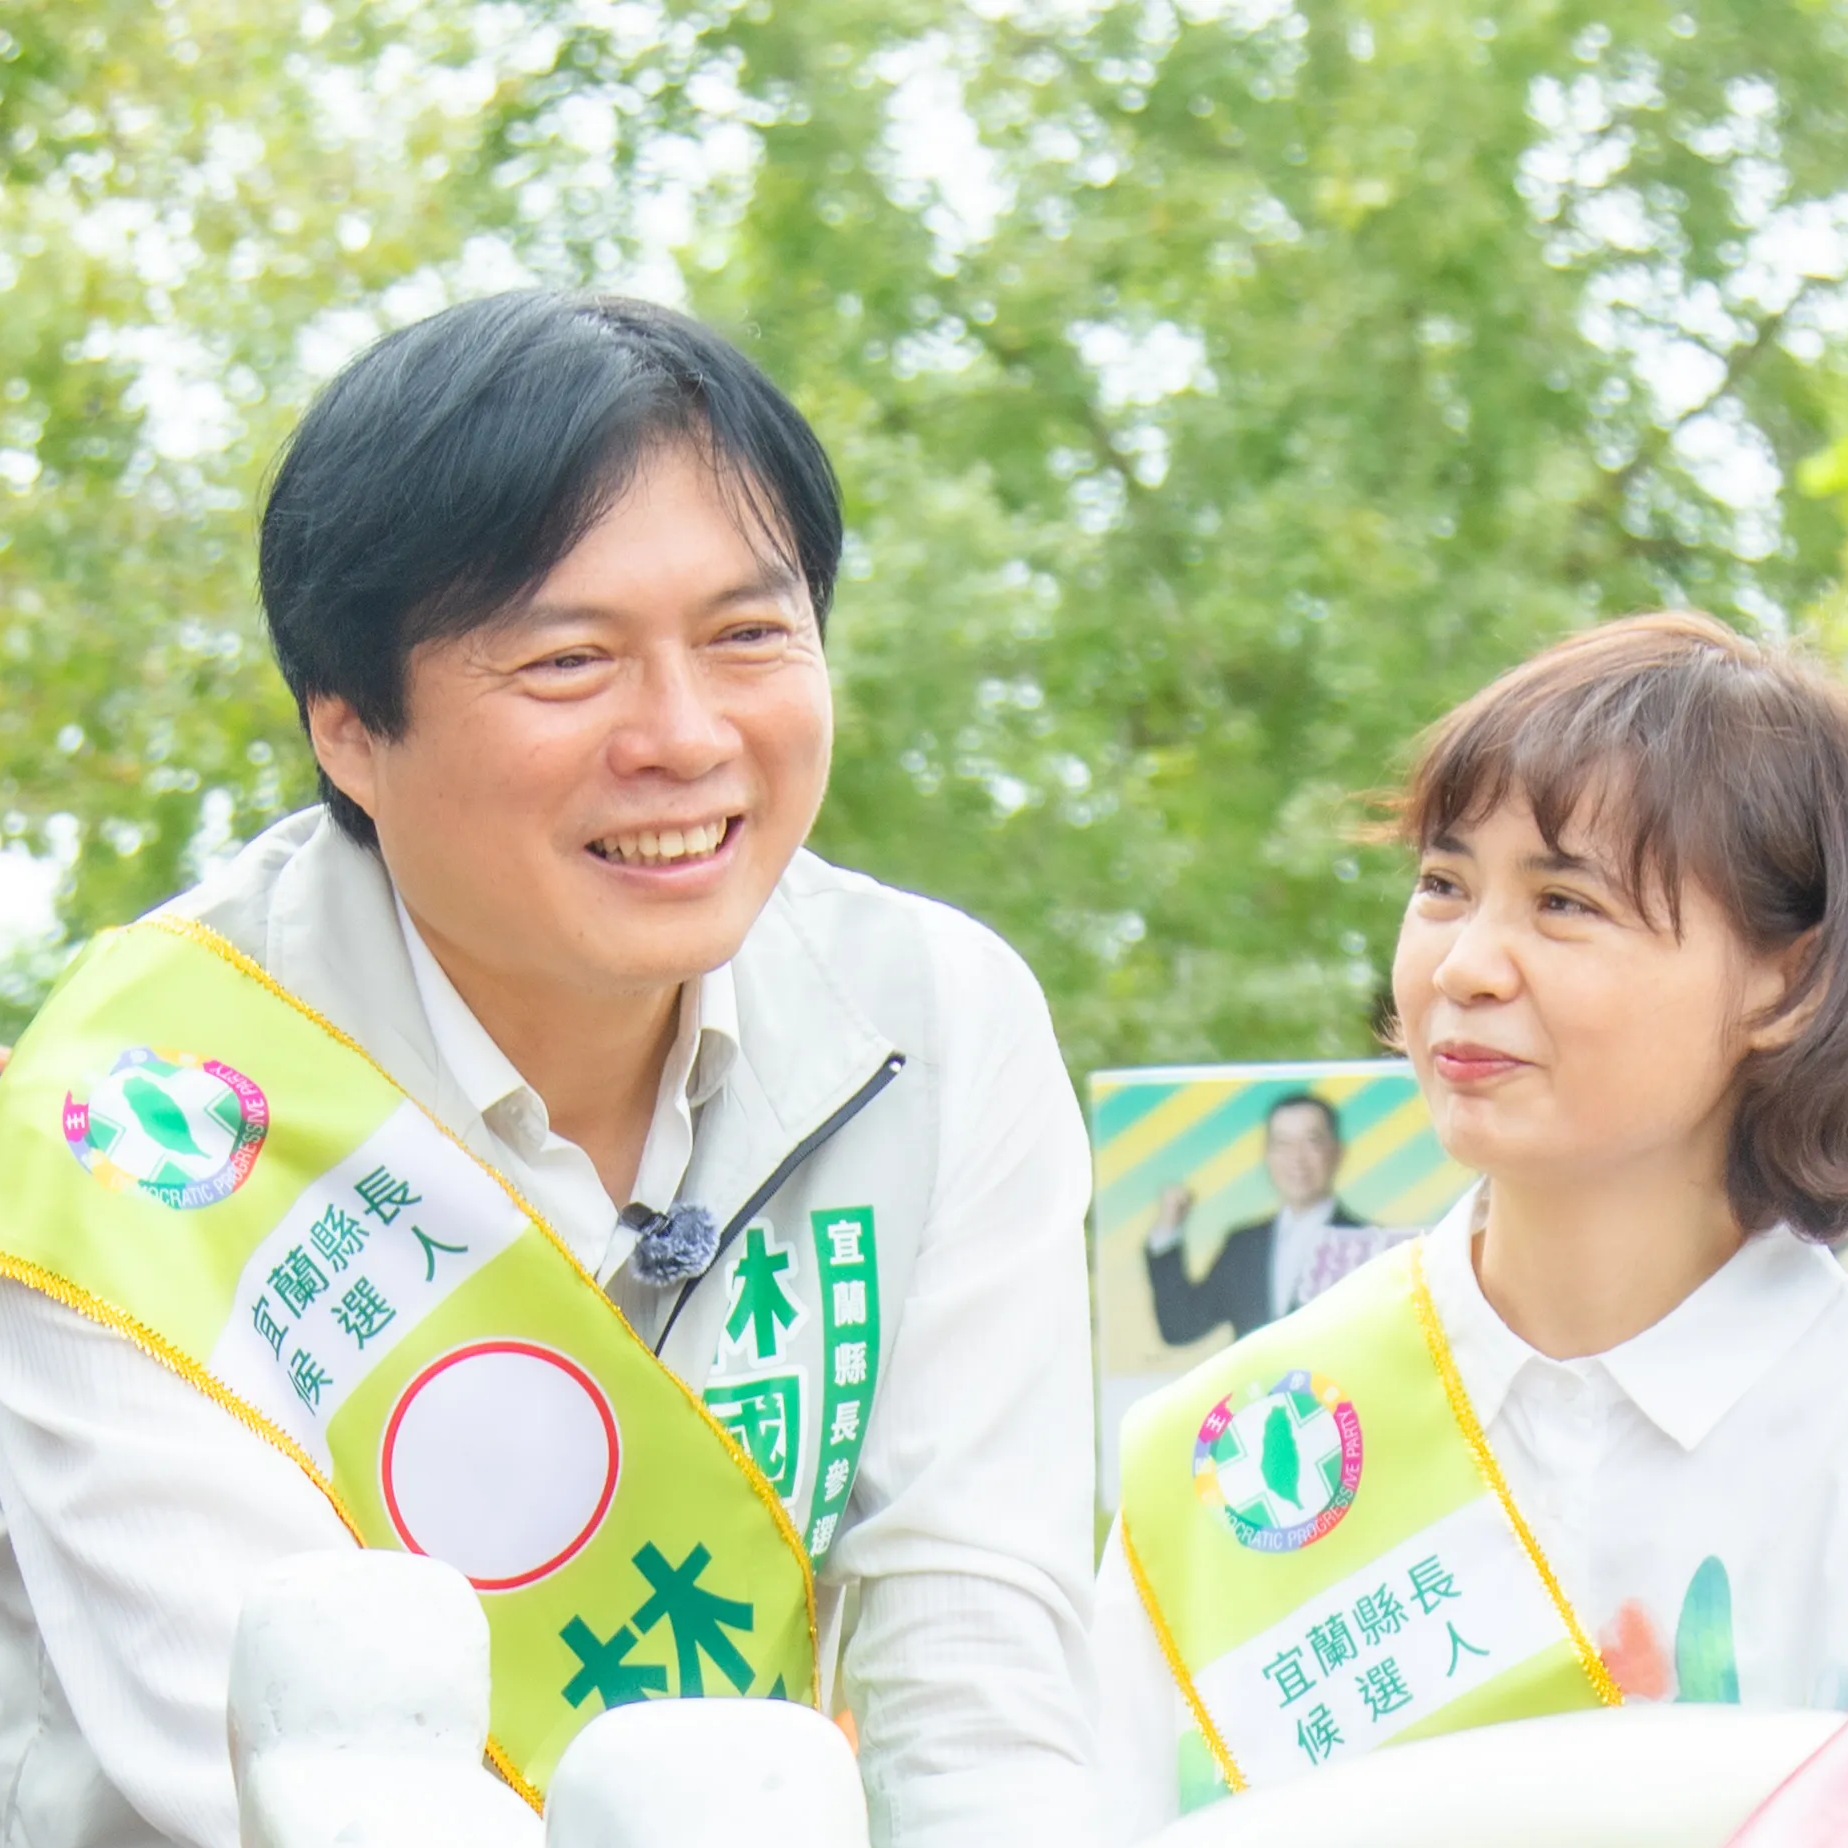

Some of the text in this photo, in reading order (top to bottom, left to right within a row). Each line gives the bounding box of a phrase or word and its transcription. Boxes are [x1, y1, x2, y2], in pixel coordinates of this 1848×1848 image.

[209, 1063, 258, 1097] PARTY
[214, 1096, 266, 1195] PROGRESSIVE
[251, 1164, 423, 1362] 宜蘭縣長
[287, 1224, 469, 1418] 候選人
[1287, 1462, 1361, 1548] PROGRESSIVE
[1336, 1409, 1361, 1459] PARTY
[1261, 1553, 1462, 1710] 宜蘭縣長
[1296, 1620, 1491, 1767] 候選人
